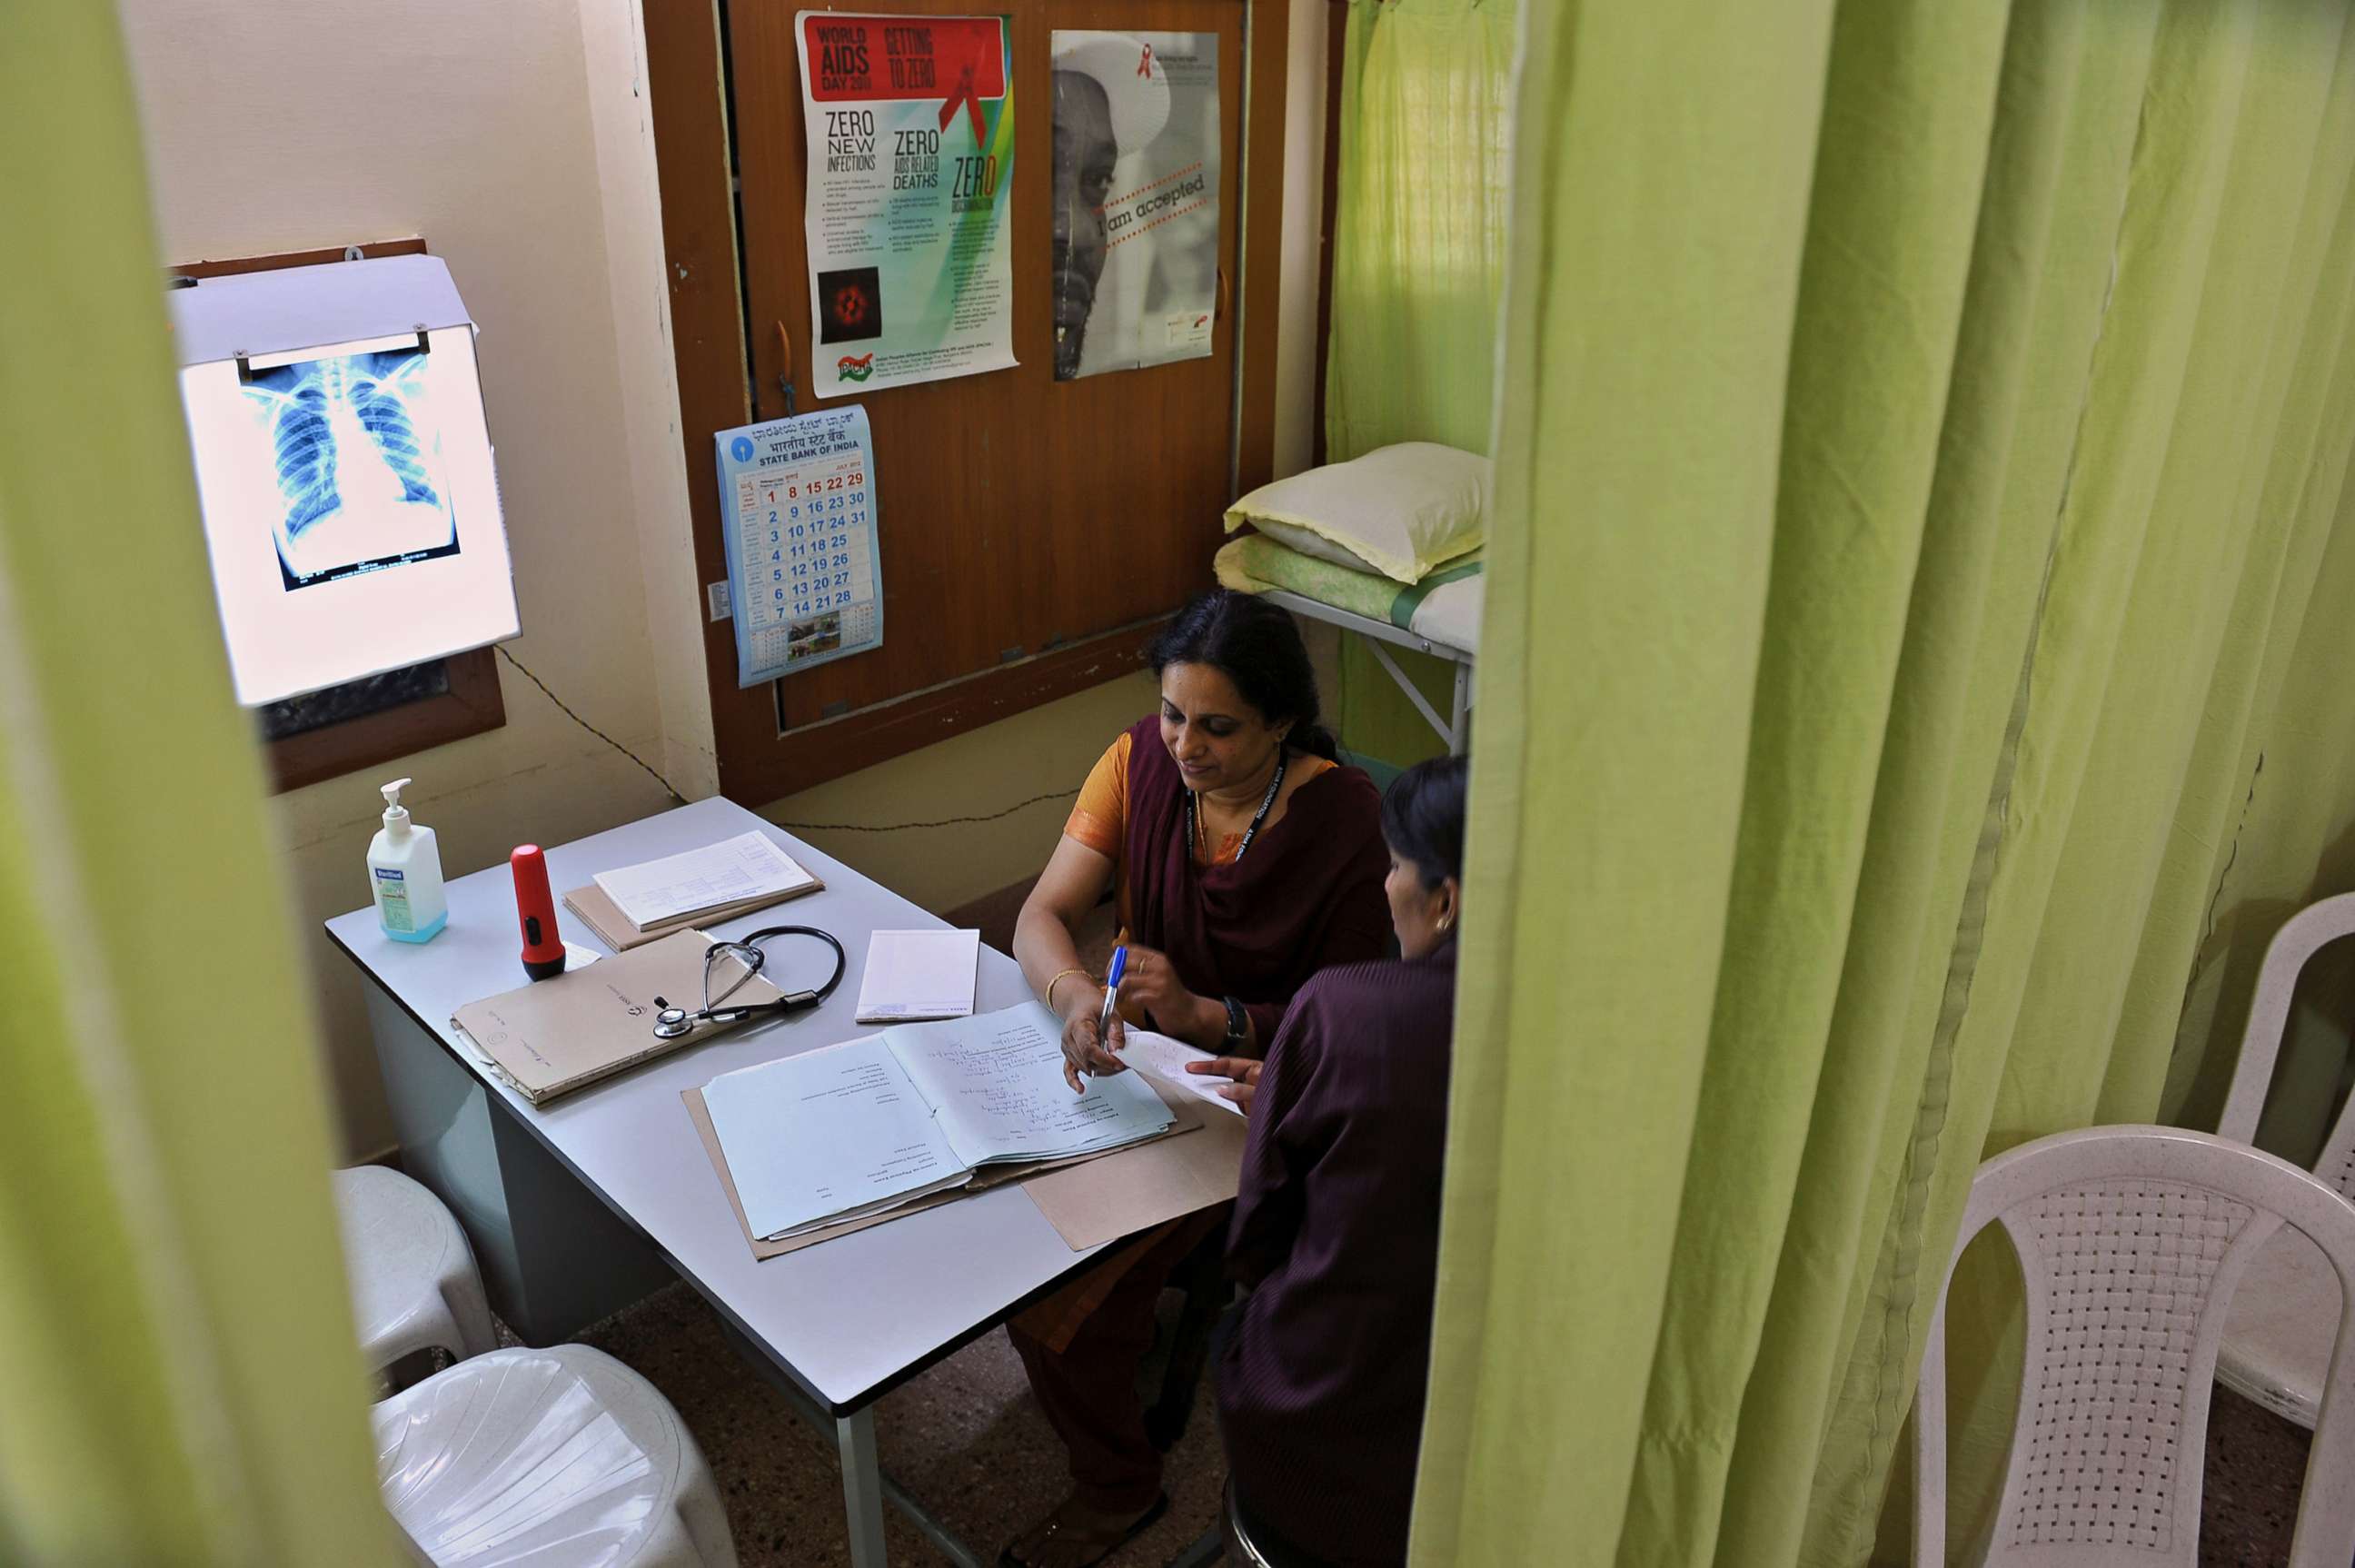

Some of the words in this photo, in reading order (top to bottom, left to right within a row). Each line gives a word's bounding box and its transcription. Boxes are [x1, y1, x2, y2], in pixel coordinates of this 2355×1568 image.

[817, 26, 867, 44] WORLD
[884, 27, 934, 55] GETTING
[821, 45, 869, 74] AIDS
[889, 58, 905, 88] TO
[906, 58, 937, 88] ZERO
[821, 76, 848, 90] DAY
[825, 110, 874, 136] ZERO
[828, 137, 875, 154] NEW
[893, 129, 939, 155] ZERO
[828, 154, 876, 172] INFECTIONS
[952, 155, 996, 198] ZERO
[893, 173, 939, 190] DEATHS
[1108, 210, 1132, 232] am
[1136, 174, 1205, 217] accepted
[760, 455, 789, 466] STATE
[791, 448, 817, 461] BANK
[820, 445, 830, 455] OF
[834, 441, 859, 452] INDIA
[770, 436, 805, 452] भारतीय
[808, 432, 825, 447] स्टेट
[826, 428, 846, 442] बैंक
[768, 491, 775, 502] 1
[789, 487, 797, 498] 8
[807, 481, 821, 494] 15
[827, 477, 843, 491] 22
[848, 472, 863, 486] 29
[770, 511, 778, 523] 2
[790, 506, 799, 518] 9
[808, 501, 823, 514] 16
[829, 496, 844, 510] 23
[849, 491, 864, 504] 30
[770, 531, 779, 542] 3
[789, 525, 803, 537] 10
[810, 521, 824, 533] 17
[830, 516, 845, 529] 24
[851, 511, 865, 523] 31
[771, 550, 780, 561] 4
[790, 545, 805, 557] 11
[810, 540, 826, 552] 18
[831, 534, 847, 548] 25
[773, 570, 781, 581] 5
[791, 563, 807, 577] 12
[811, 558, 827, 571] 19
[832, 553, 848, 567] 26
[774, 589, 783, 600] 6
[792, 582, 809, 596] 13
[813, 577, 830, 590] 20
[834, 572, 849, 585] 27
[777, 607, 785, 619] 7
[794, 601, 810, 614] 14
[816, 596, 830, 609] 21
[835, 590, 851, 603] 28
